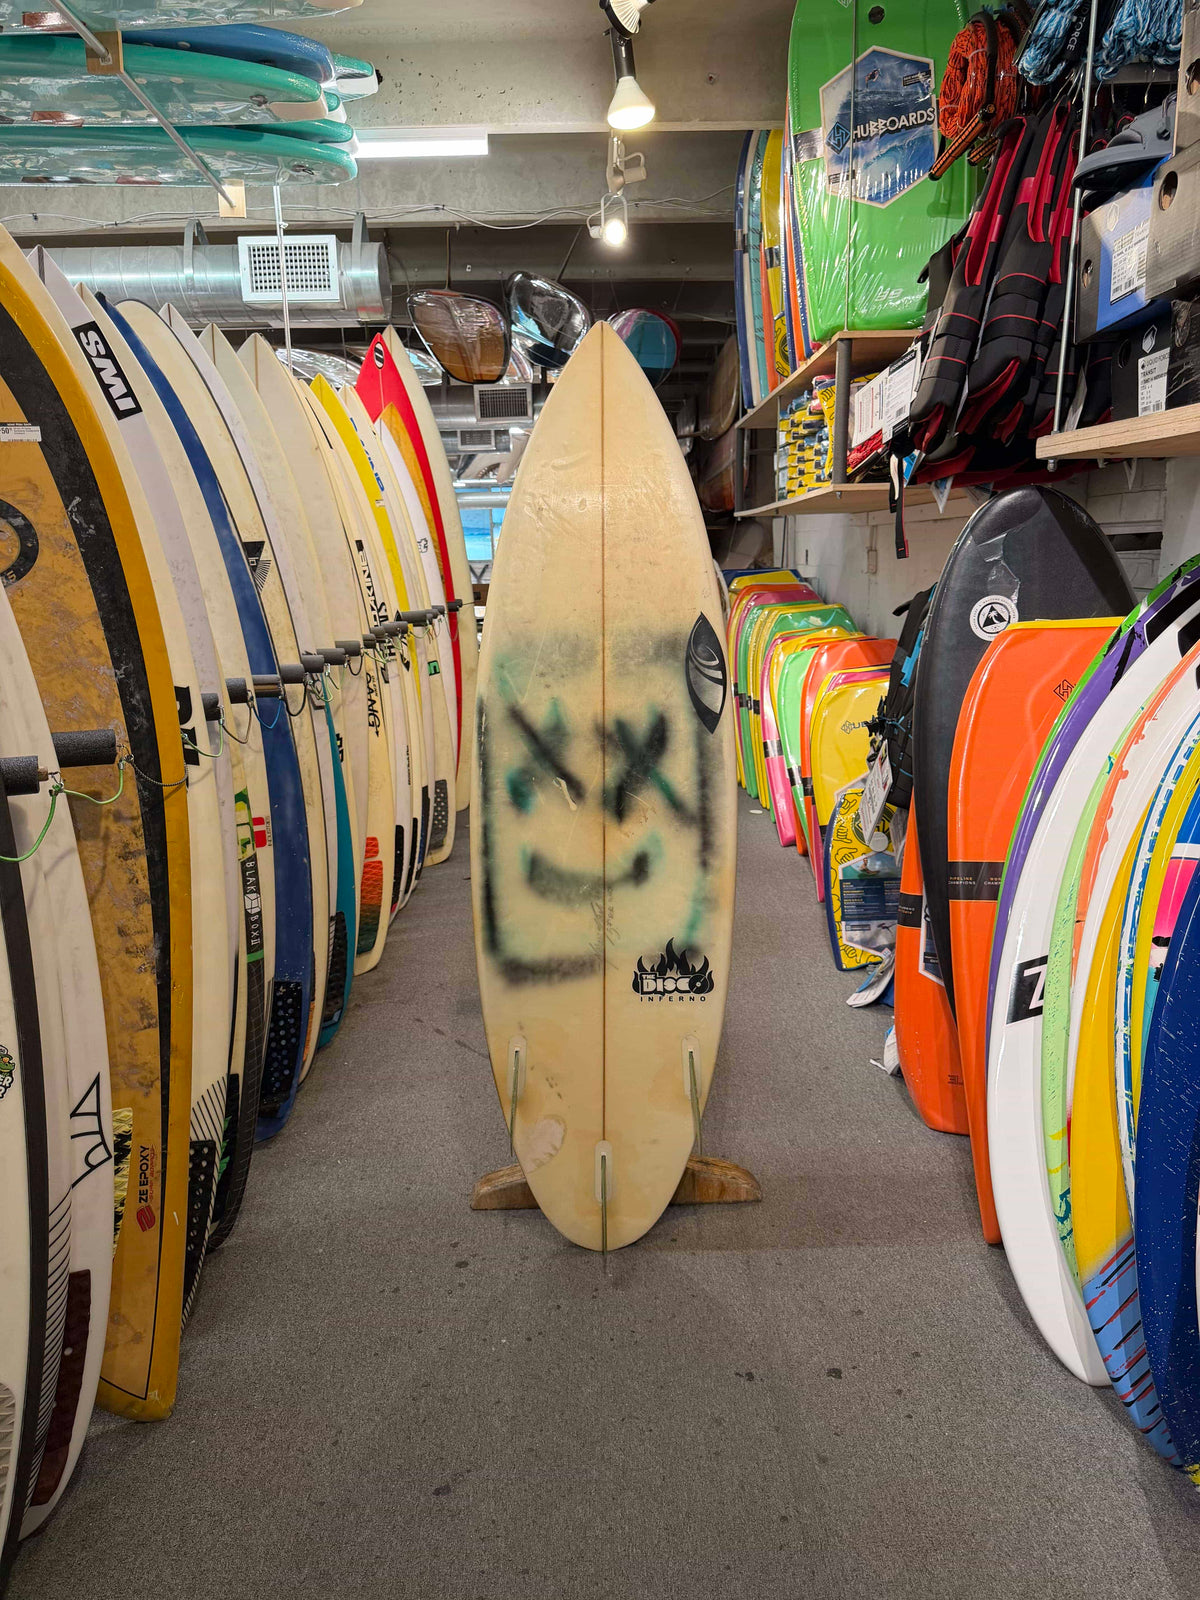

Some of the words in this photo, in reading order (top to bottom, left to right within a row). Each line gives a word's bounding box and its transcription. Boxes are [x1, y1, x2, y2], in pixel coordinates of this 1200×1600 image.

[852, 106, 936, 140] HUBBOARDS
[640, 995, 707, 1003] INFERNO
[139, 1145, 150, 1188] EPOXY
[138, 1189, 148, 1203] ZE
